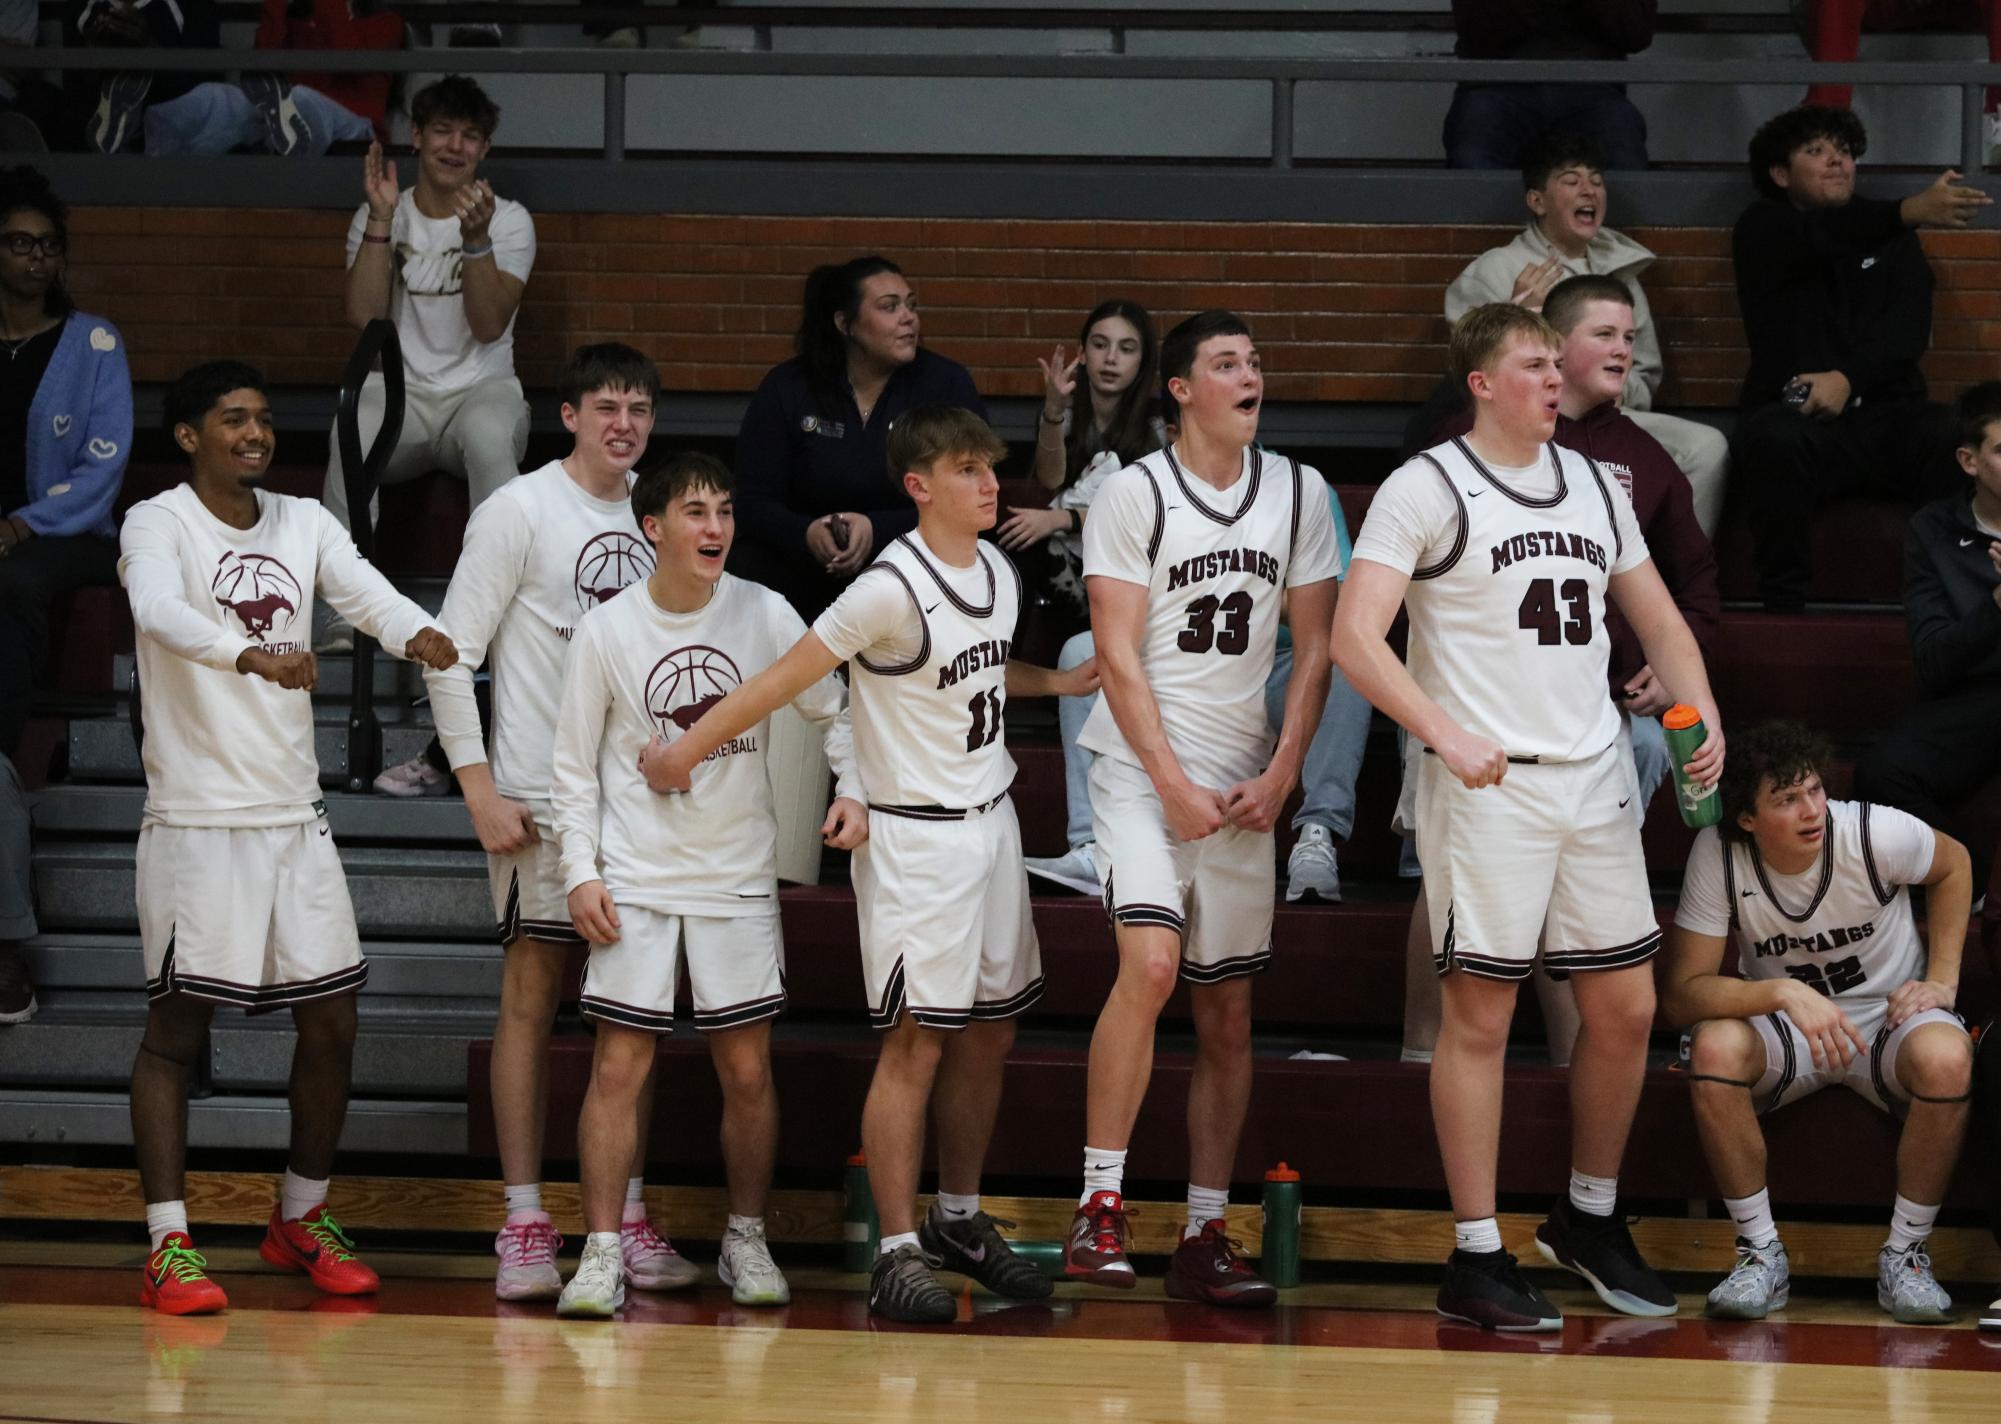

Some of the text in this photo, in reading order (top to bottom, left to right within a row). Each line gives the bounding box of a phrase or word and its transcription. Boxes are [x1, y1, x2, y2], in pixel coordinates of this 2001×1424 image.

[1167, 547, 1279, 593] MUSTANGS
[1490, 531, 1607, 575] MUSTANGS
[1177, 590, 1254, 656] 33
[1518, 578, 1593, 646] 43
[936, 639, 1011, 690] MUSTAN
[966, 685, 1001, 753] 11
[1753, 921, 1875, 958] MUSTANGS
[1784, 955, 1868, 997] 22
